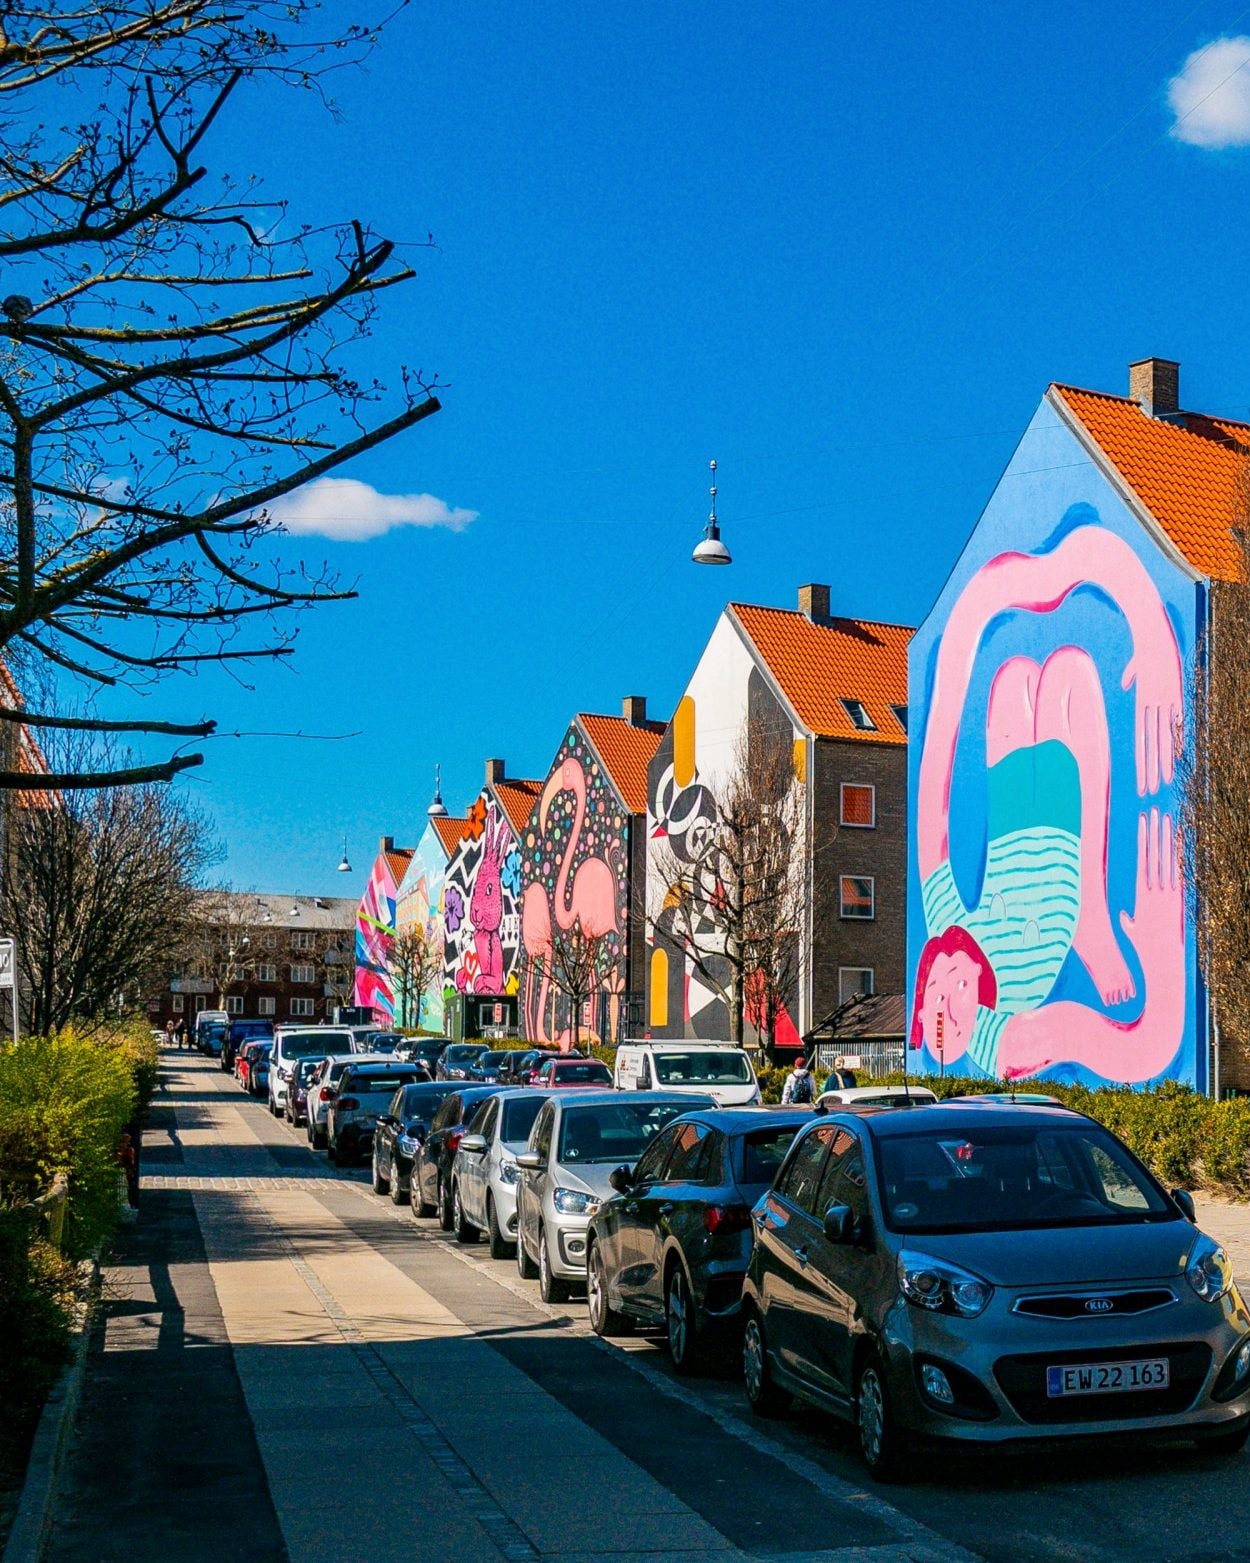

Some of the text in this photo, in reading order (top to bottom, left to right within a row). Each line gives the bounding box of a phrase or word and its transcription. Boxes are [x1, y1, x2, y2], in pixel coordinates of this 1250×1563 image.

[1089, 1300, 1109, 1311] KIA
[1064, 1363, 1166, 1391] EW 22 163
